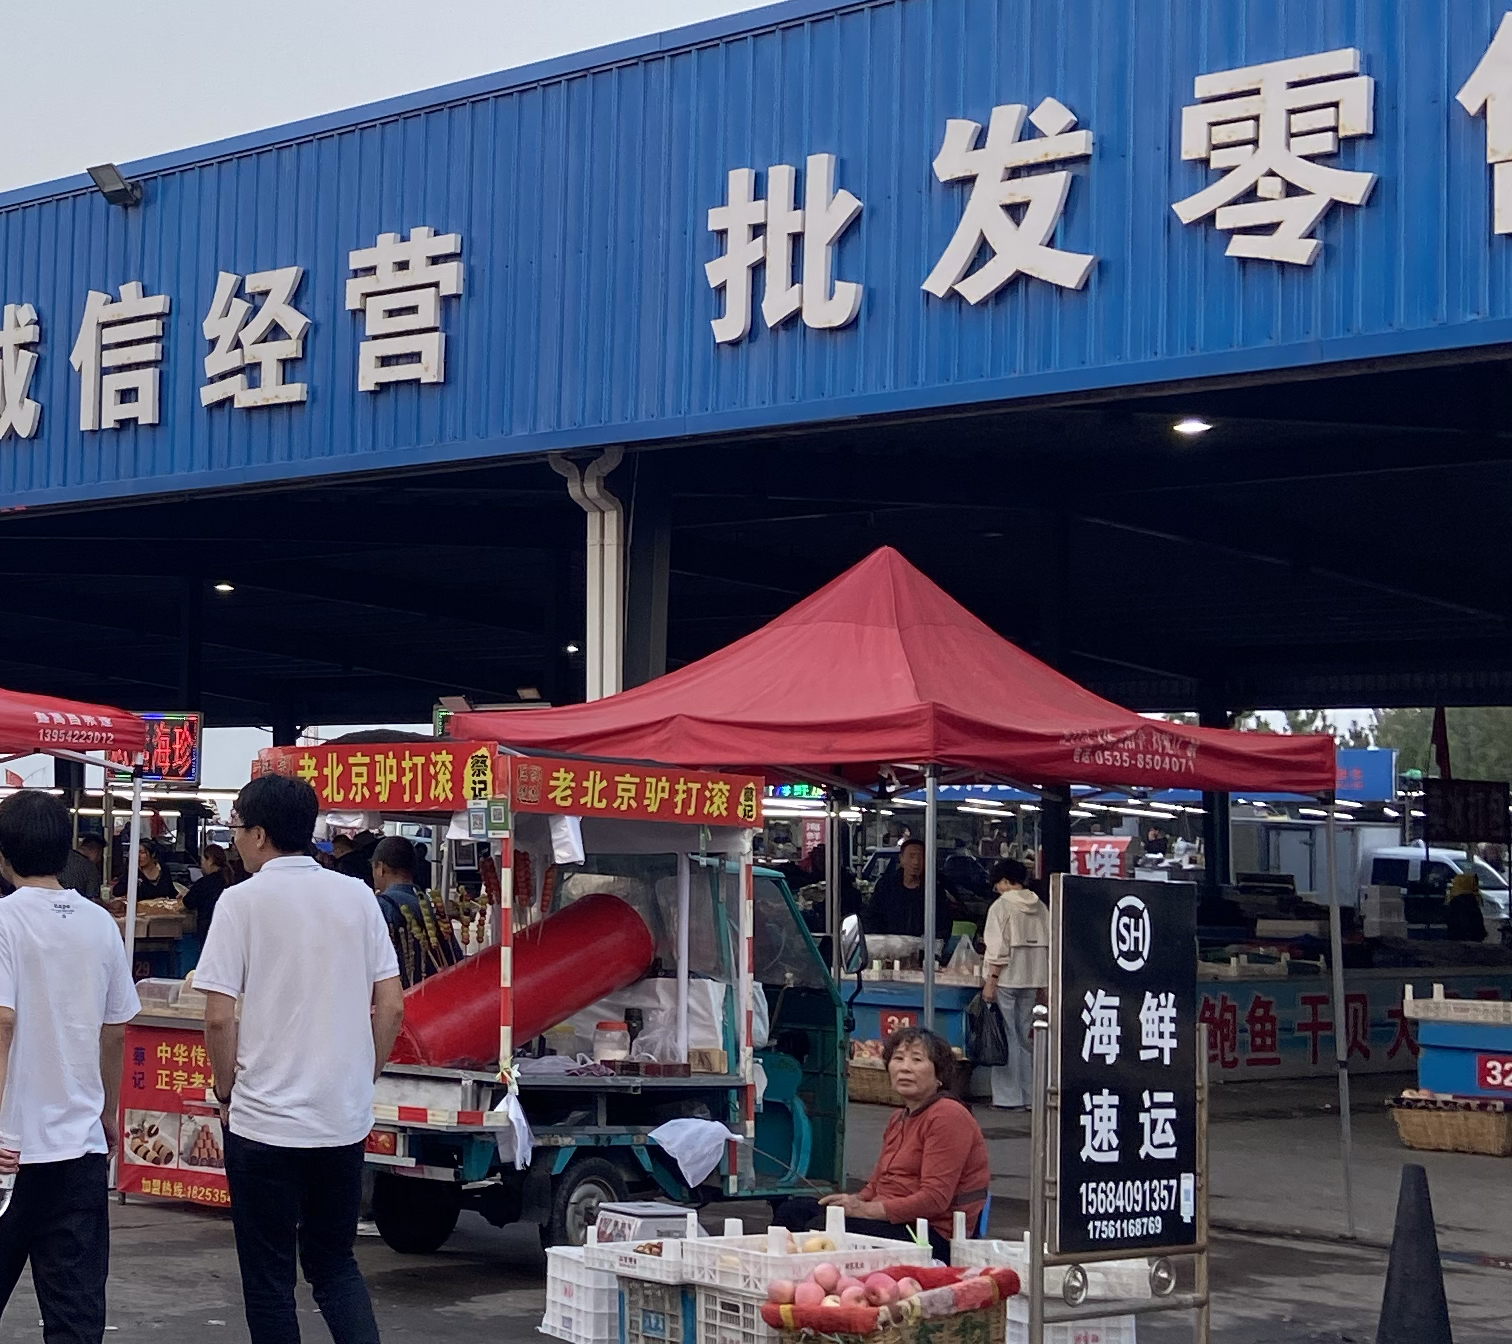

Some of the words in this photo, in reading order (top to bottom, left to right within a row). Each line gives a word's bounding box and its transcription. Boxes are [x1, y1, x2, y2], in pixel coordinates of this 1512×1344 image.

[297, 748, 454, 803] 老北京驴打滚
[548, 768, 730, 817] 老北京驴打滚
[1119, 916, 1143, 951] SH
[1082, 989, 1177, 1065] 海鲜
[156, 1042, 211, 1067] 中华传
[1486, 1061, 1512, 1086] 32
[1080, 1088, 1177, 1162] 速运
[1080, 1179, 1177, 1215] 15684091357
[1088, 1216, 1162, 1239] 17561168769
